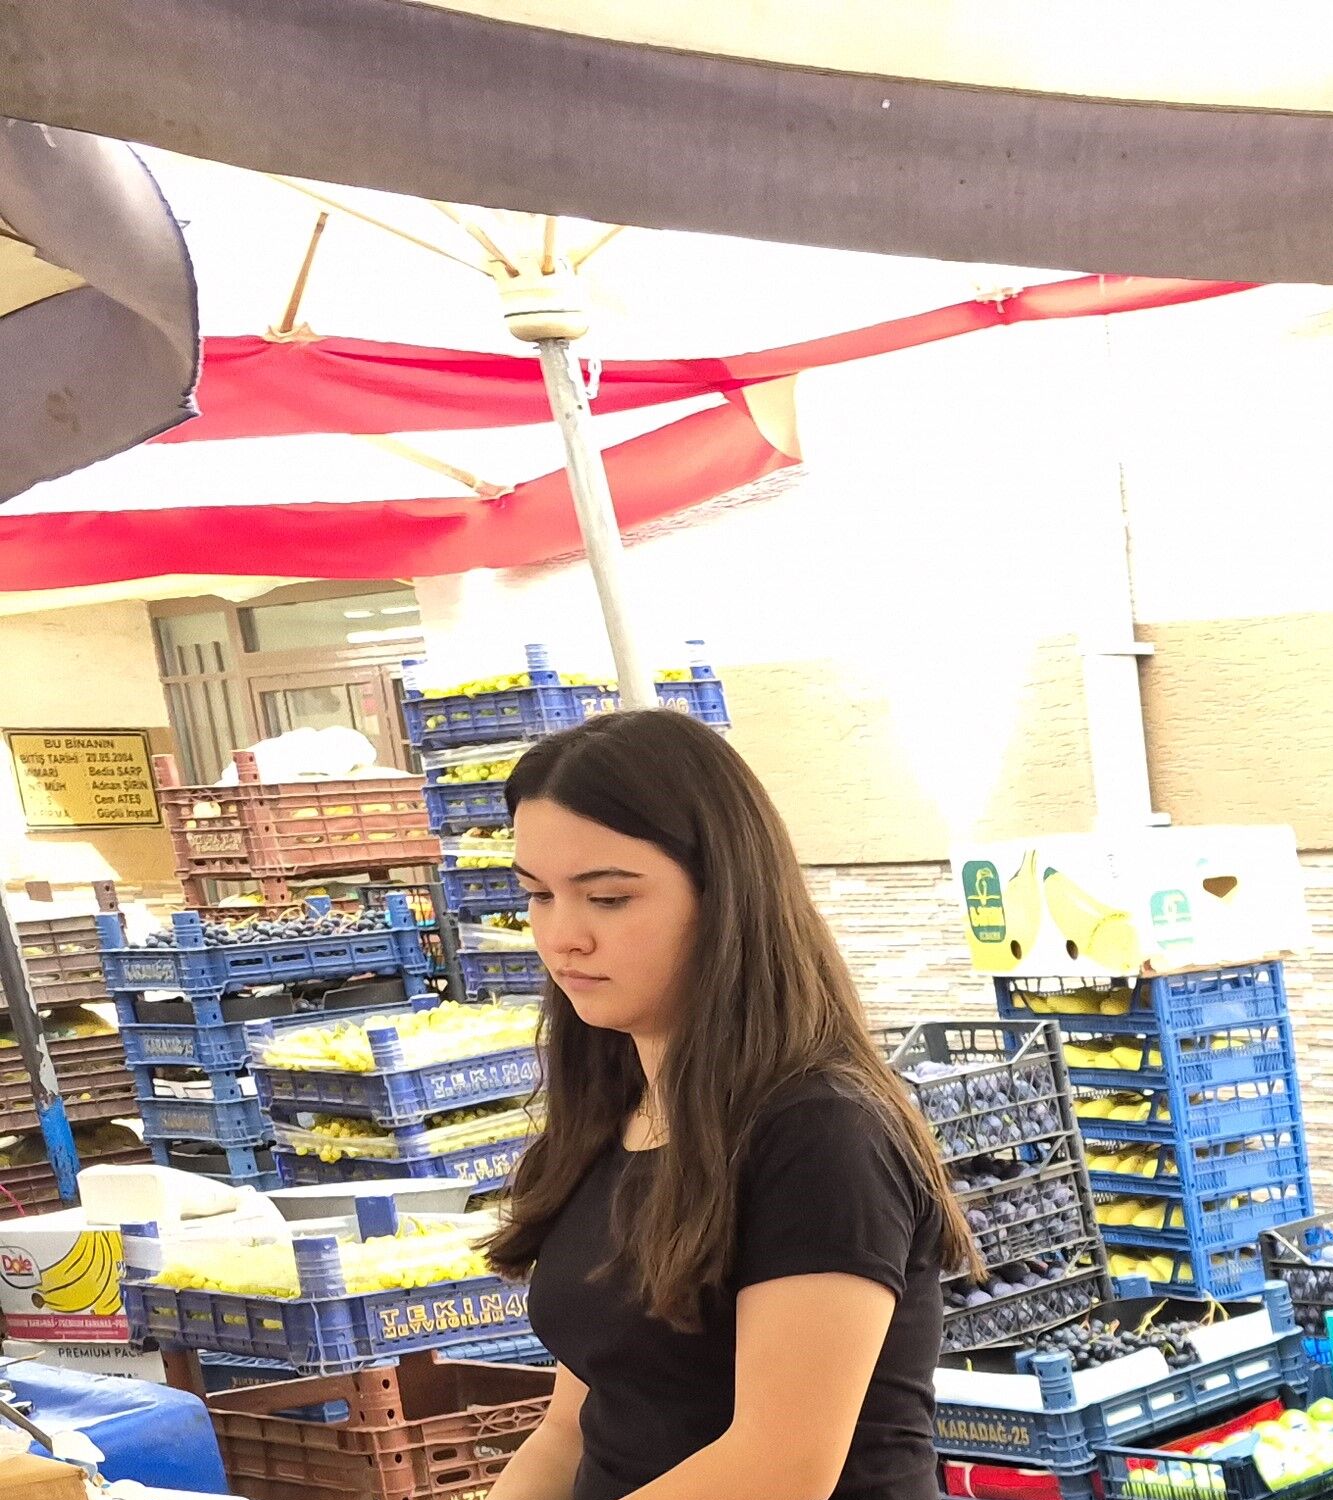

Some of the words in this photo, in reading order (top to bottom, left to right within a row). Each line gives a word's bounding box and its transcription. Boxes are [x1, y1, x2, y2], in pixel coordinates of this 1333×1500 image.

[44, 739, 61, 748] BU
[2, 1254, 33, 1271] Dole
[58, 1347, 110, 1358] PREMIUM
